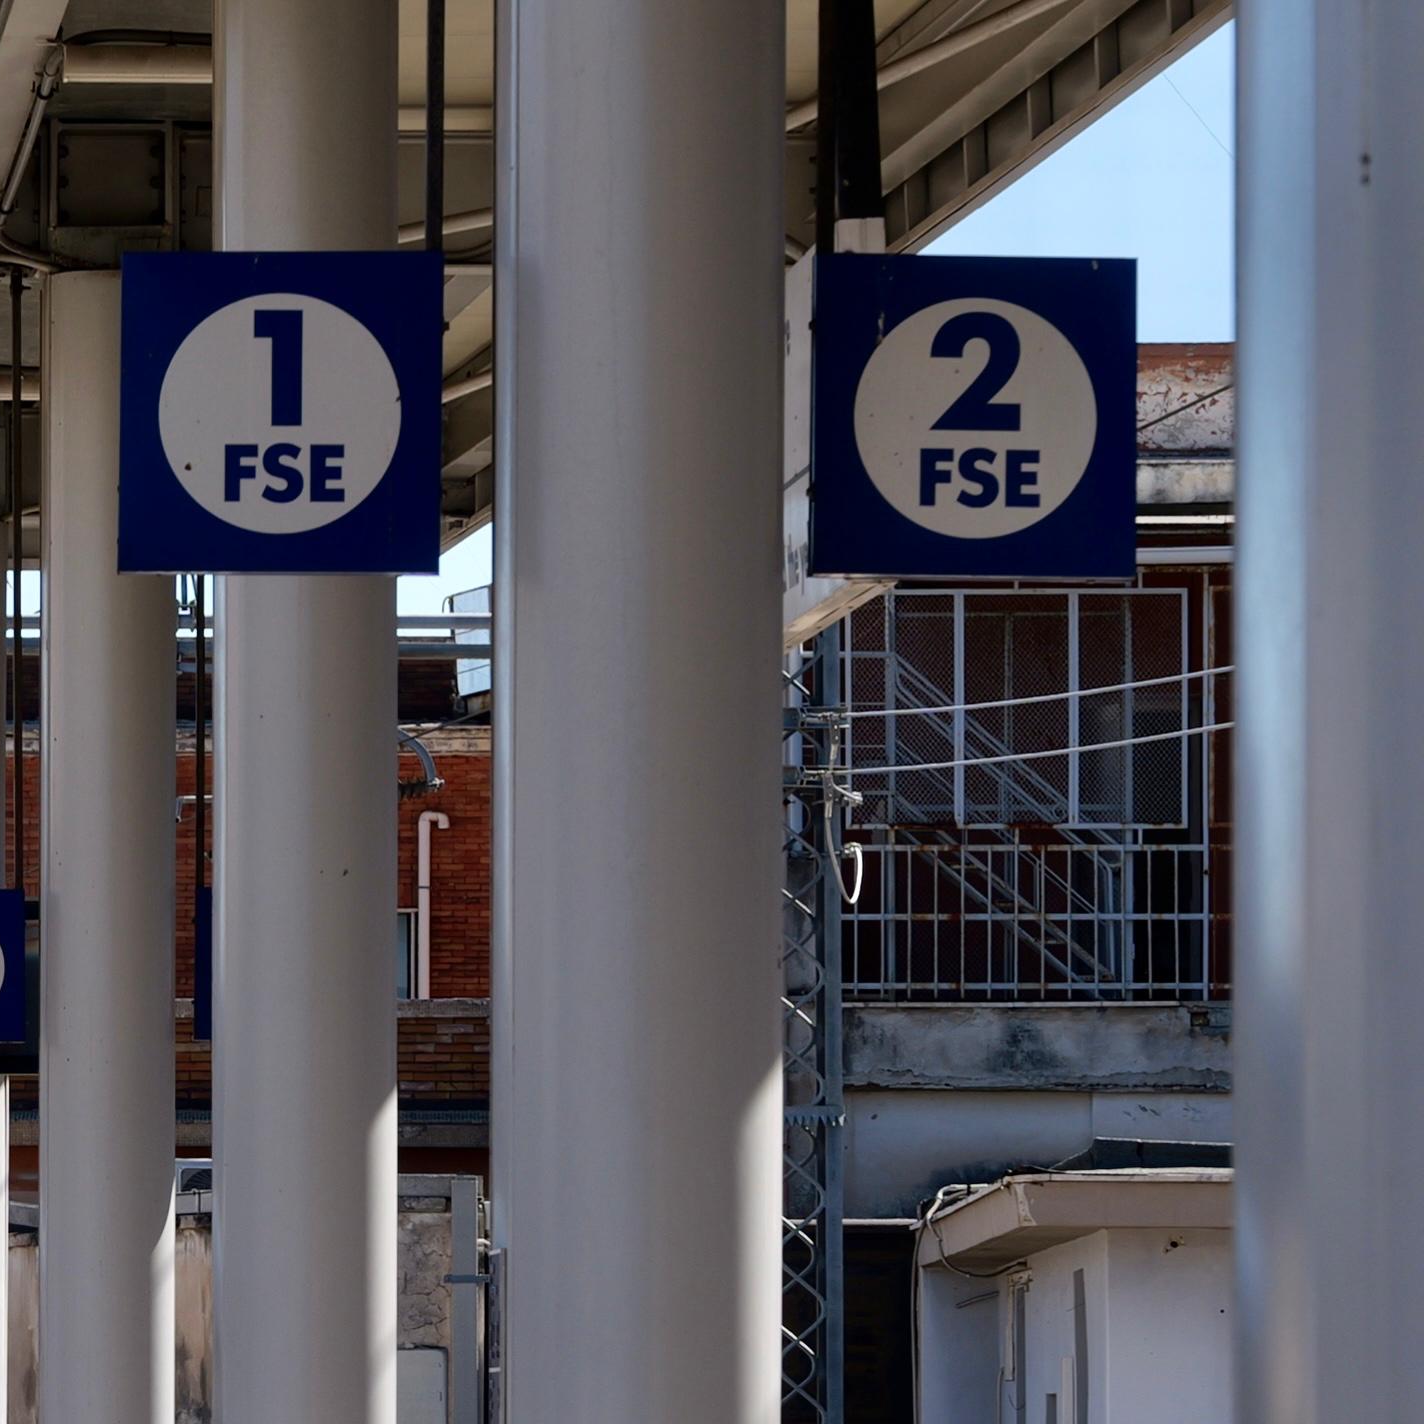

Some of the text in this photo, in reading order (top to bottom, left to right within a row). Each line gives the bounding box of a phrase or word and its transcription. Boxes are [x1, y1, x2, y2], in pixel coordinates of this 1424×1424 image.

[254, 310, 303, 426] 1
[930, 311, 1021, 431] 2
[224, 443, 345, 503] FSE
[919, 447, 1040, 508] FSE
